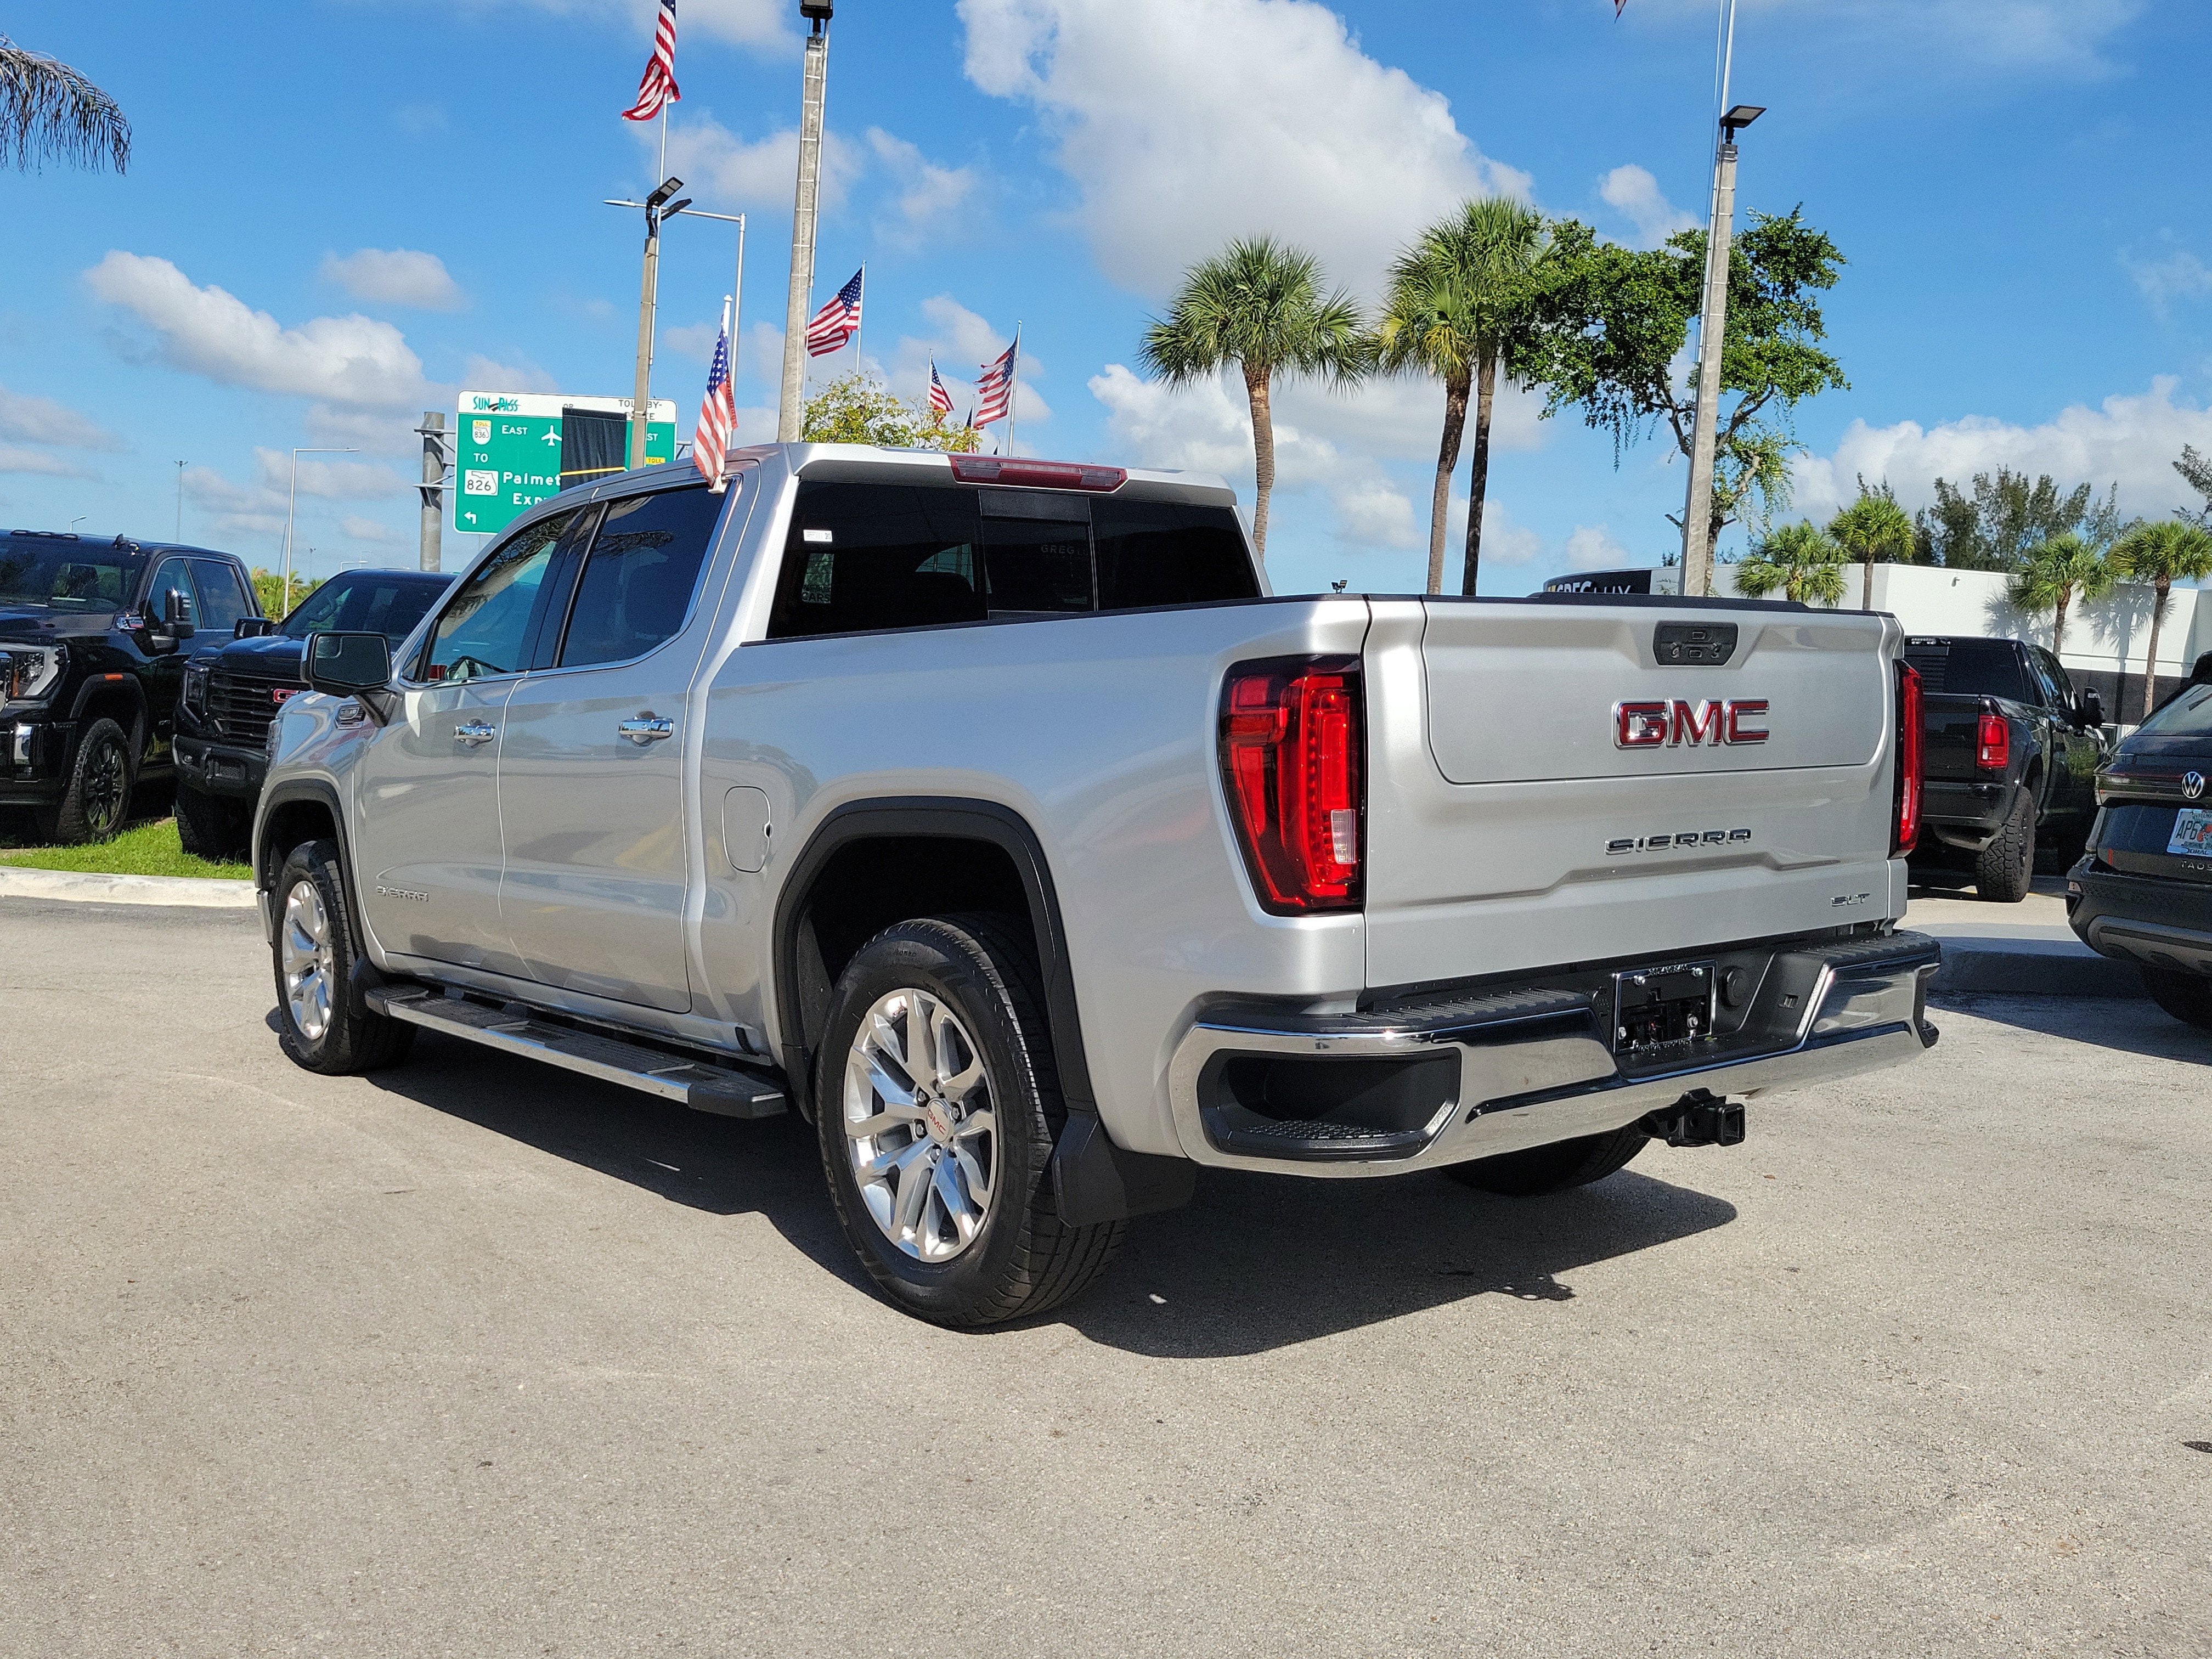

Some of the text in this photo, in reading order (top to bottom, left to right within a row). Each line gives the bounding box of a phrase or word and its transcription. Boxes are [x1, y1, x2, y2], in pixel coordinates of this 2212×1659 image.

[501, 425, 528, 435] EAST
[473, 453, 488, 463] TO
[467, 479, 492, 491] 826
[503, 471, 561, 486] Palmet
[1611, 697, 1770, 749] GMC
[1605, 828, 1752, 855] SIERRA
[376, 885, 428, 901] SIERRA
[1831, 893, 1870, 907] SLT
[928, 1109, 946, 1135] GMC
